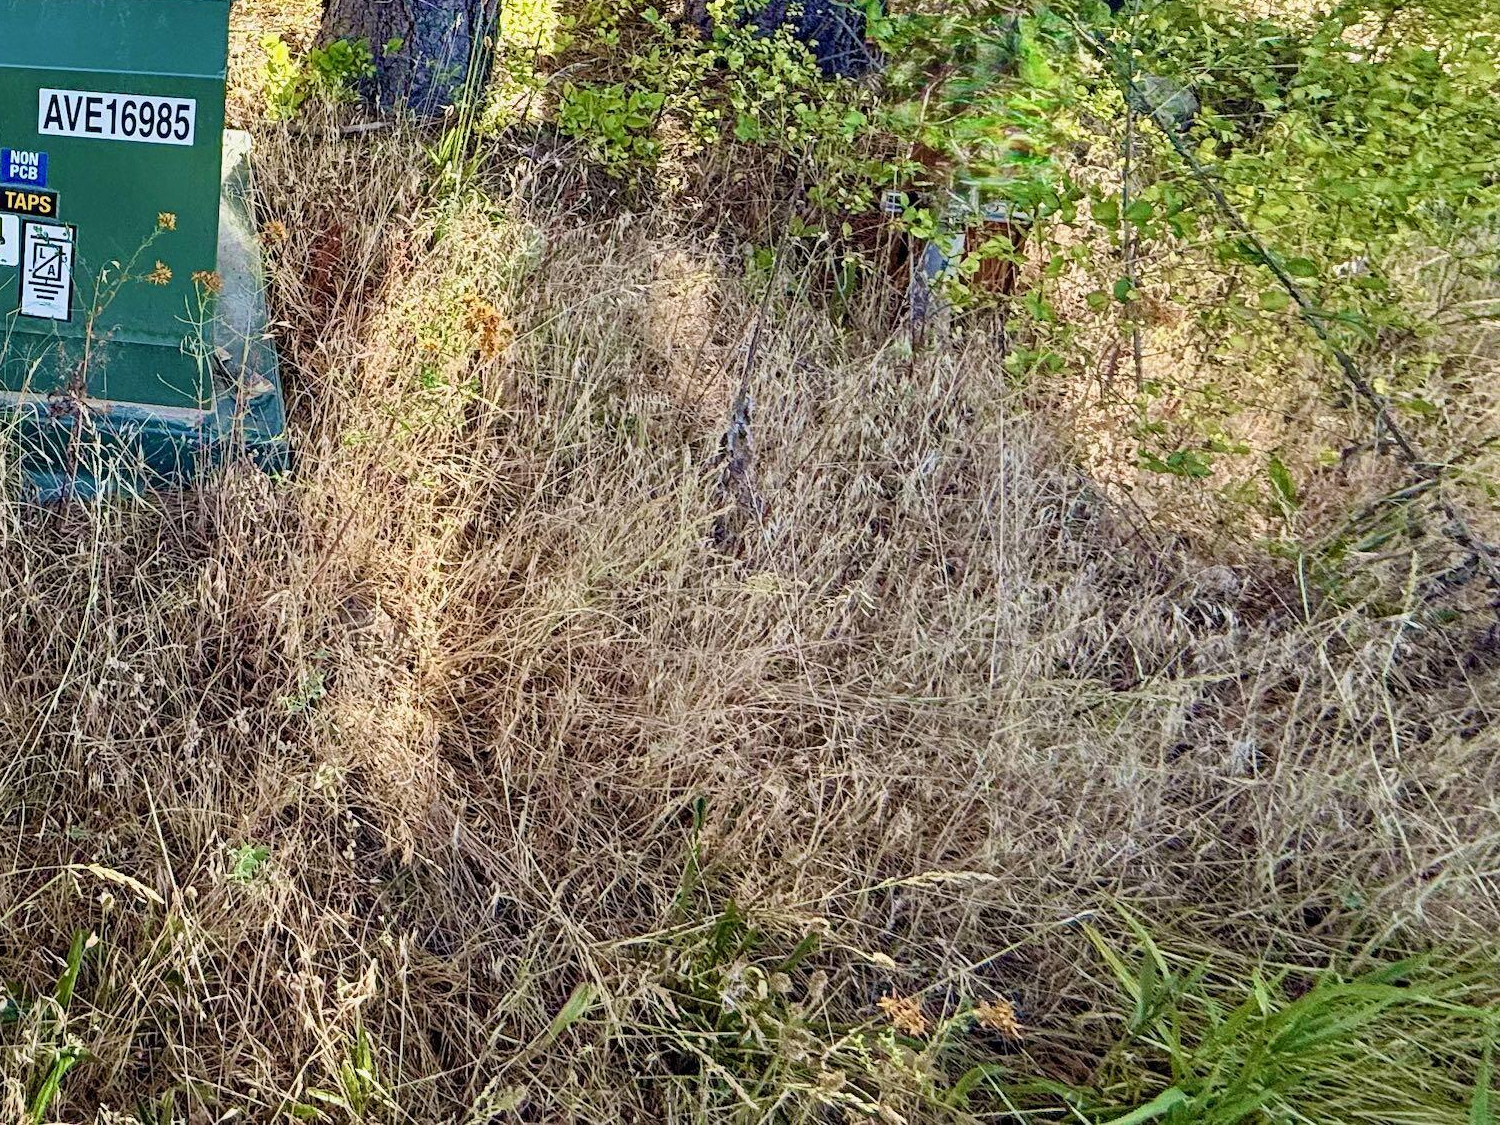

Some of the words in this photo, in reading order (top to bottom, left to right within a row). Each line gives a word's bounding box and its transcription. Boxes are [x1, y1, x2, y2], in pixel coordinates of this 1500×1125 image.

[43, 94, 191, 140] AVE16985
[10, 150, 39, 167] NON
[10, 165, 38, 181] PCB
[4, 190, 52, 214] TAPS
[47, 264, 55, 276] A
